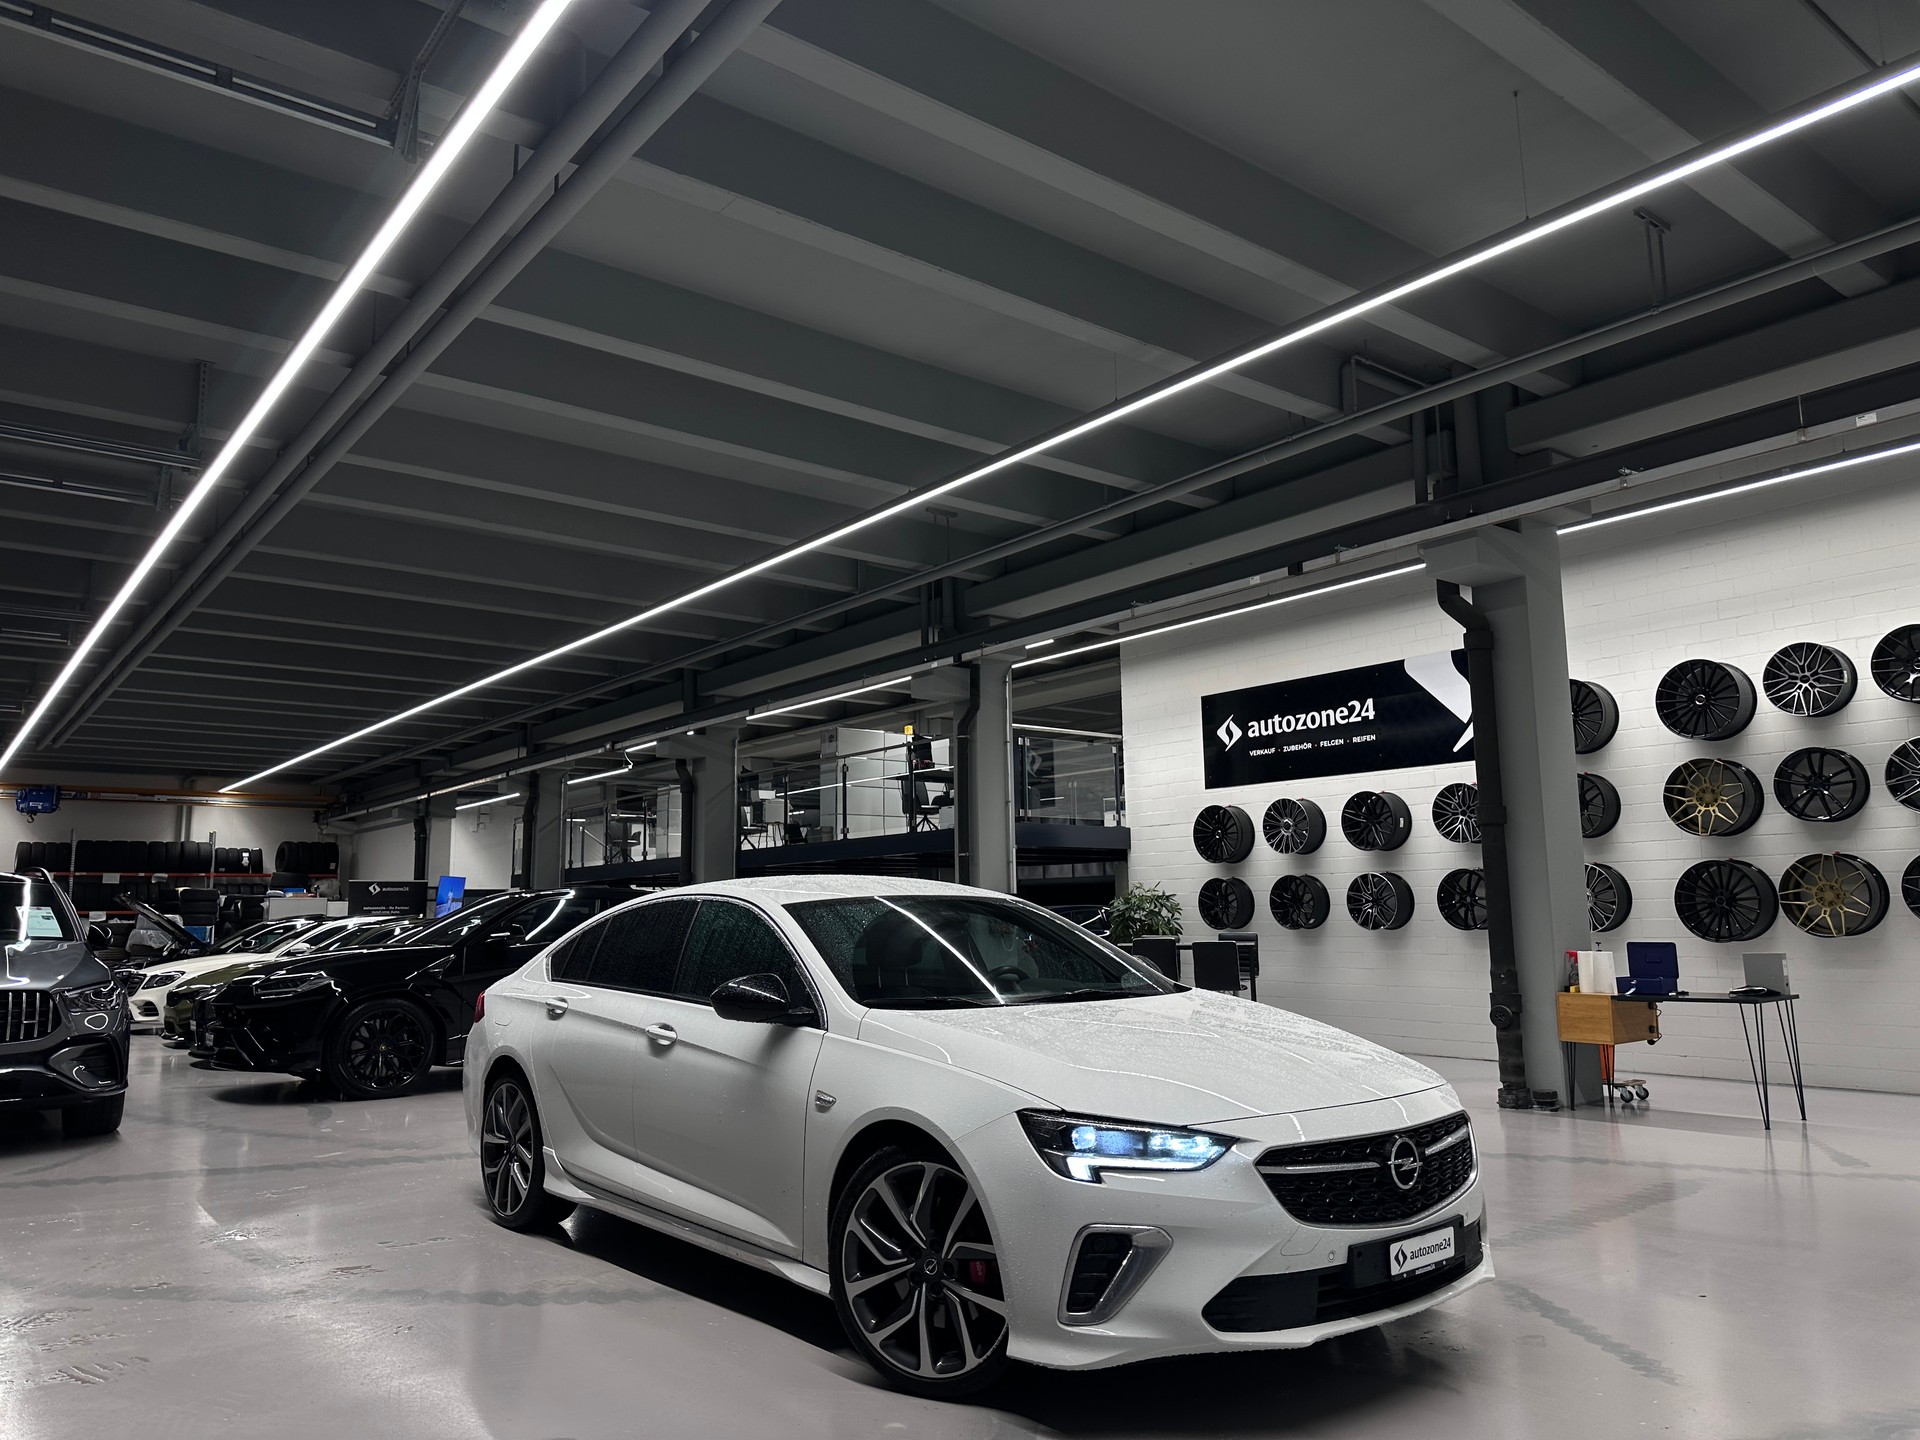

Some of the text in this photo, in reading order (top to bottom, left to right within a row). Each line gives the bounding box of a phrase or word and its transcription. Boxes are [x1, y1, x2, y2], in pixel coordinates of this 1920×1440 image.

[1247, 698, 1376, 738] autozone24
[1249, 734, 1376, 757] VERKAUF ZUBEHÖR FELGEN REIFEN
[1410, 1237, 1451, 1260] autozone24
